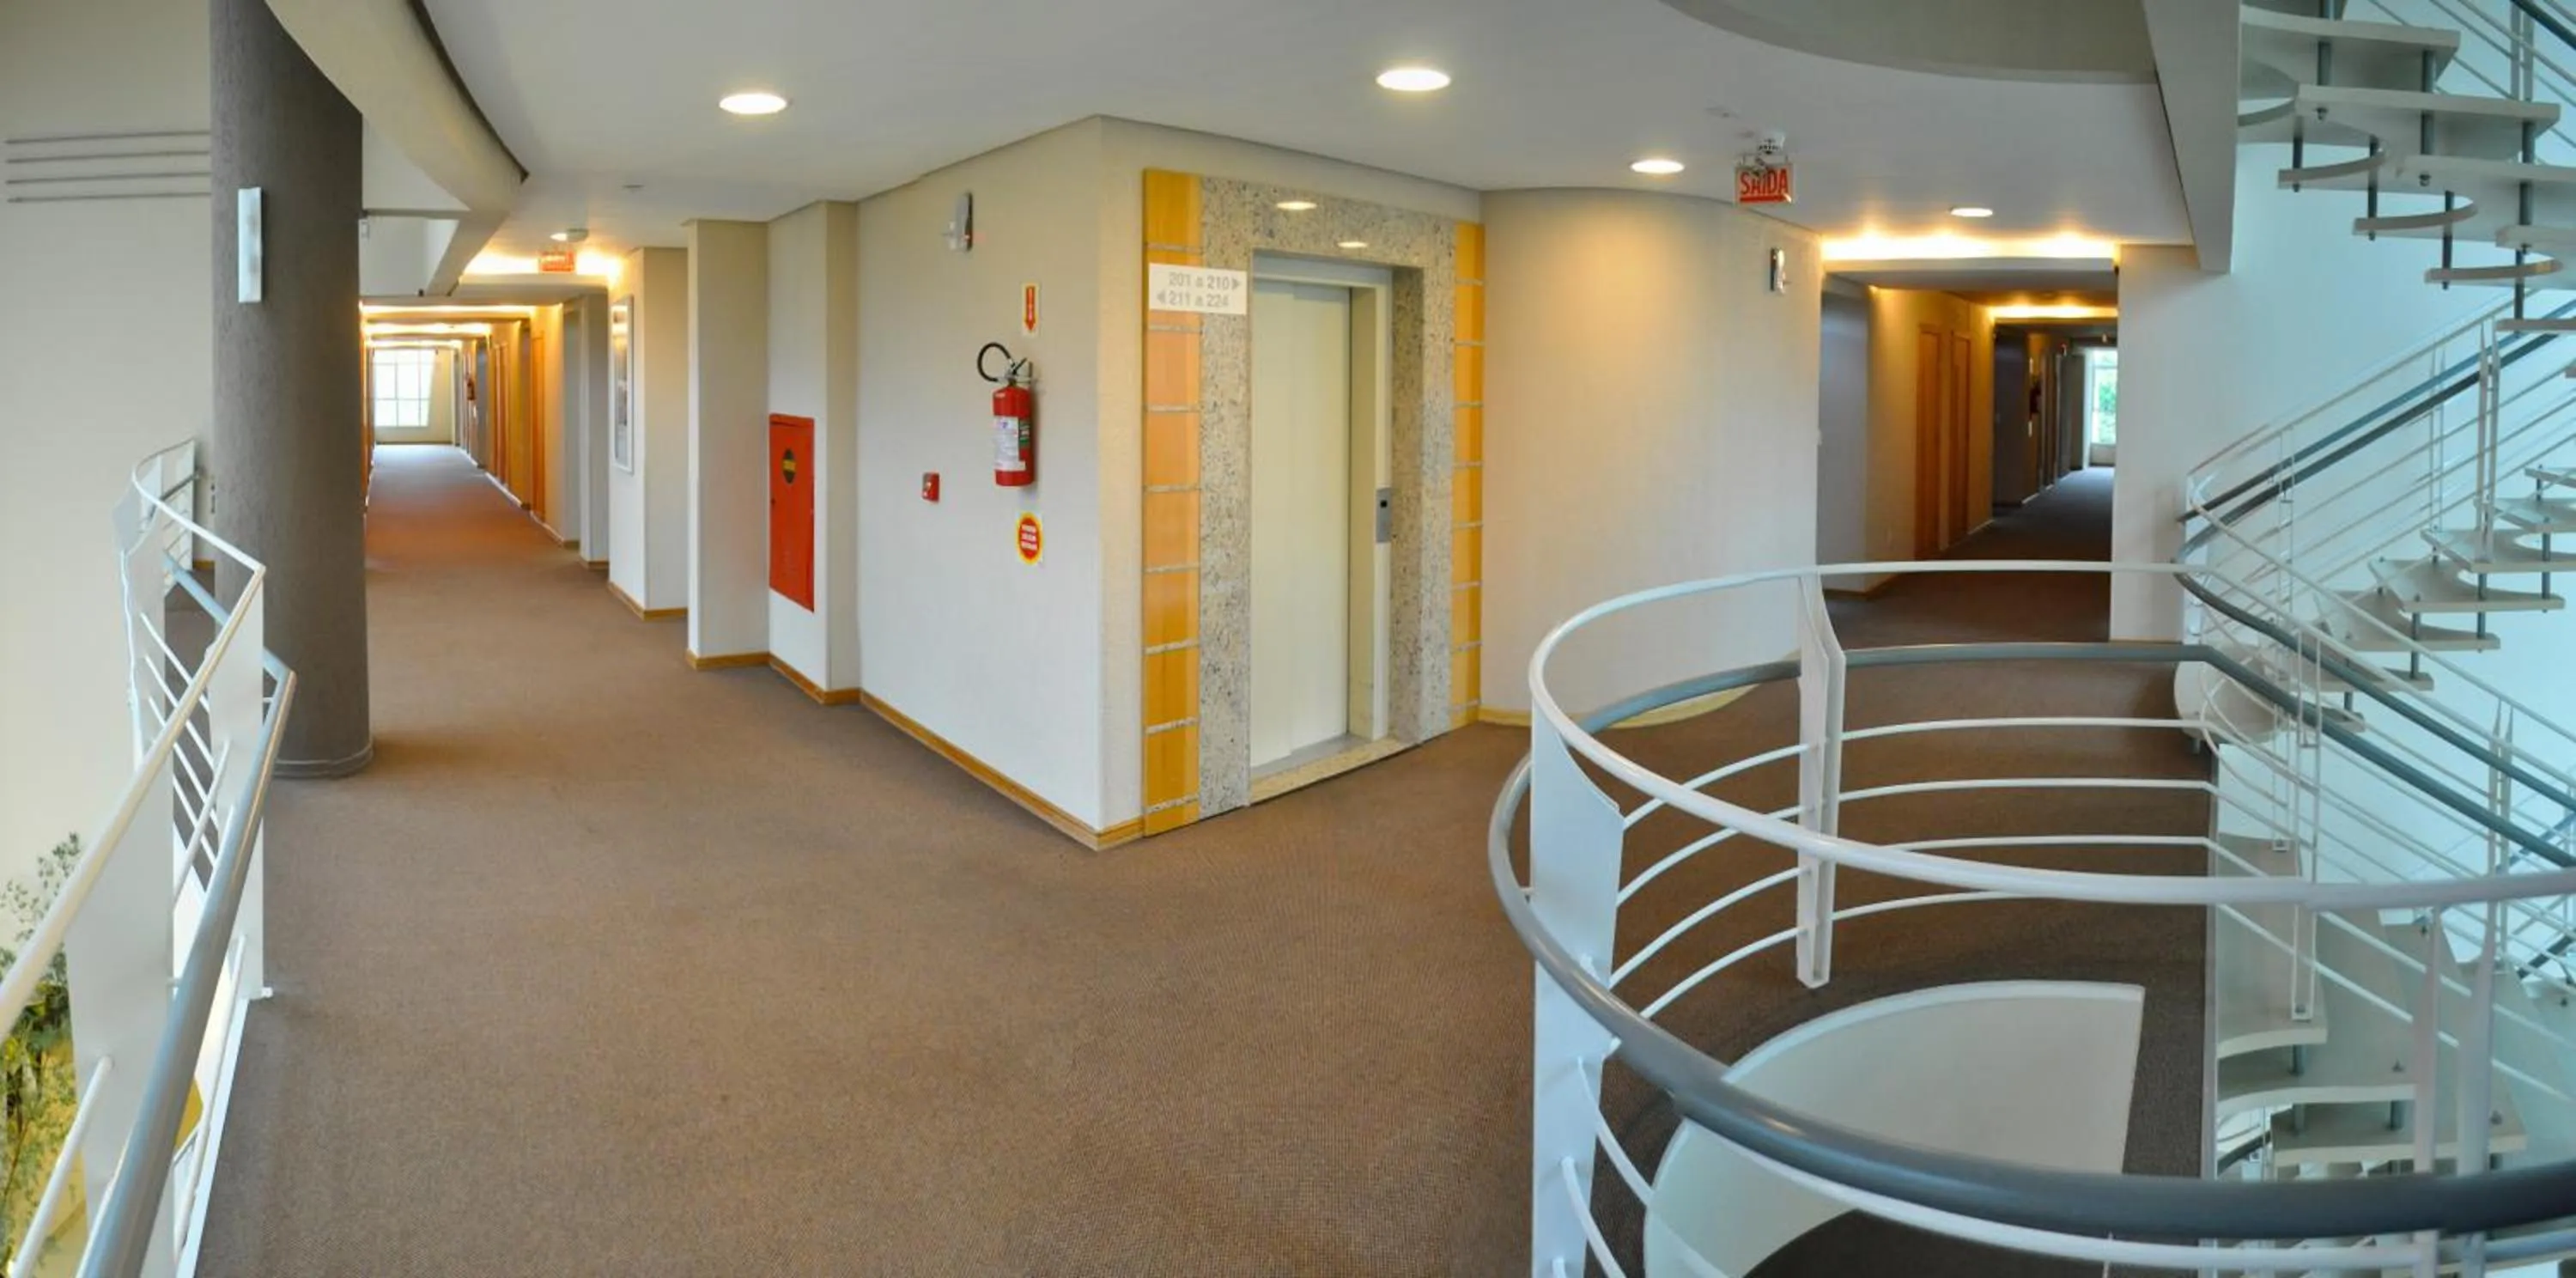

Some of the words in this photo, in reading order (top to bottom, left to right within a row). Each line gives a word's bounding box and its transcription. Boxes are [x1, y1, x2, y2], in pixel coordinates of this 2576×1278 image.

[1169, 271, 1191, 287] 201
[1206, 275, 1230, 290] 210
[1169, 290, 1191, 307] 211
[1206, 293, 1229, 307] 224
